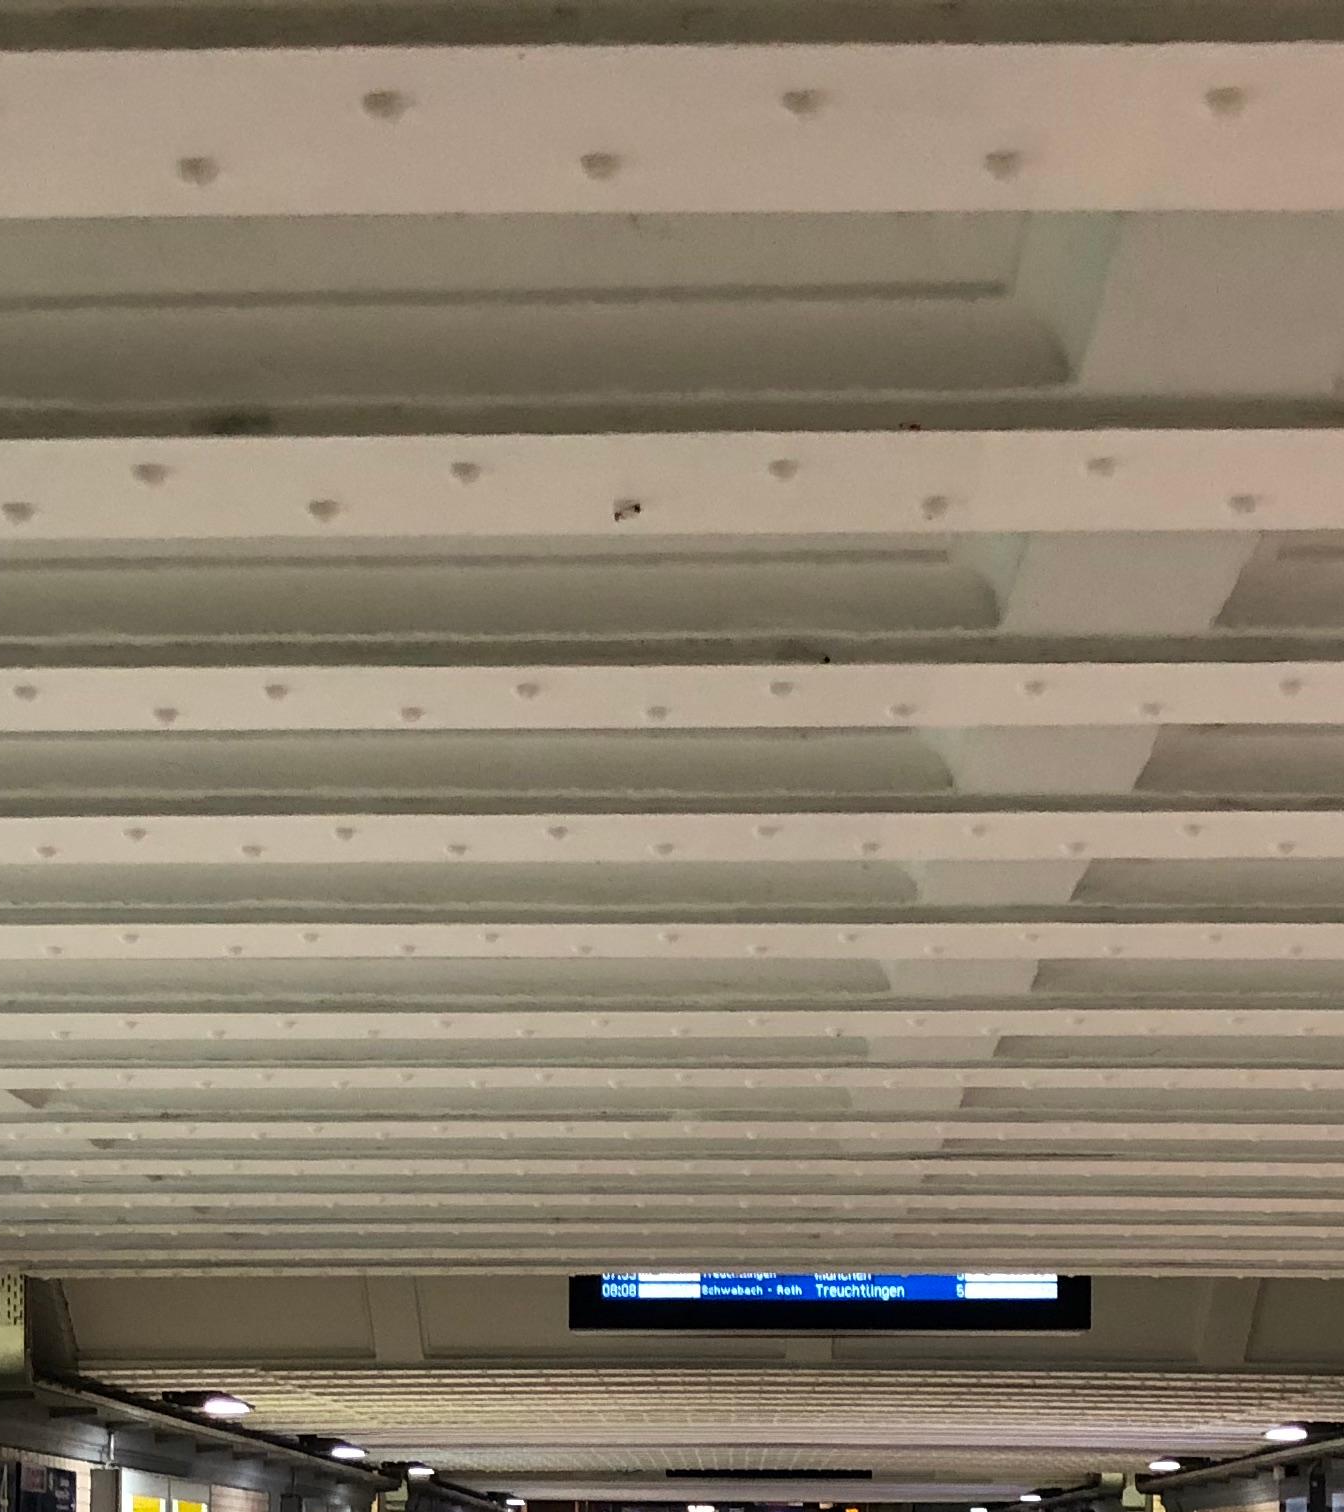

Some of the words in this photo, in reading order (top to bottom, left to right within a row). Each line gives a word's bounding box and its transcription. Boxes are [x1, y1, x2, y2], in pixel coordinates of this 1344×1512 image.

[602, 1283, 637, 1298] 08:08
[701, 1284, 763, 1296] Schwabach
[776, 1284, 803, 1296] Roth
[815, 1284, 905, 1301] Treuchtlingen
